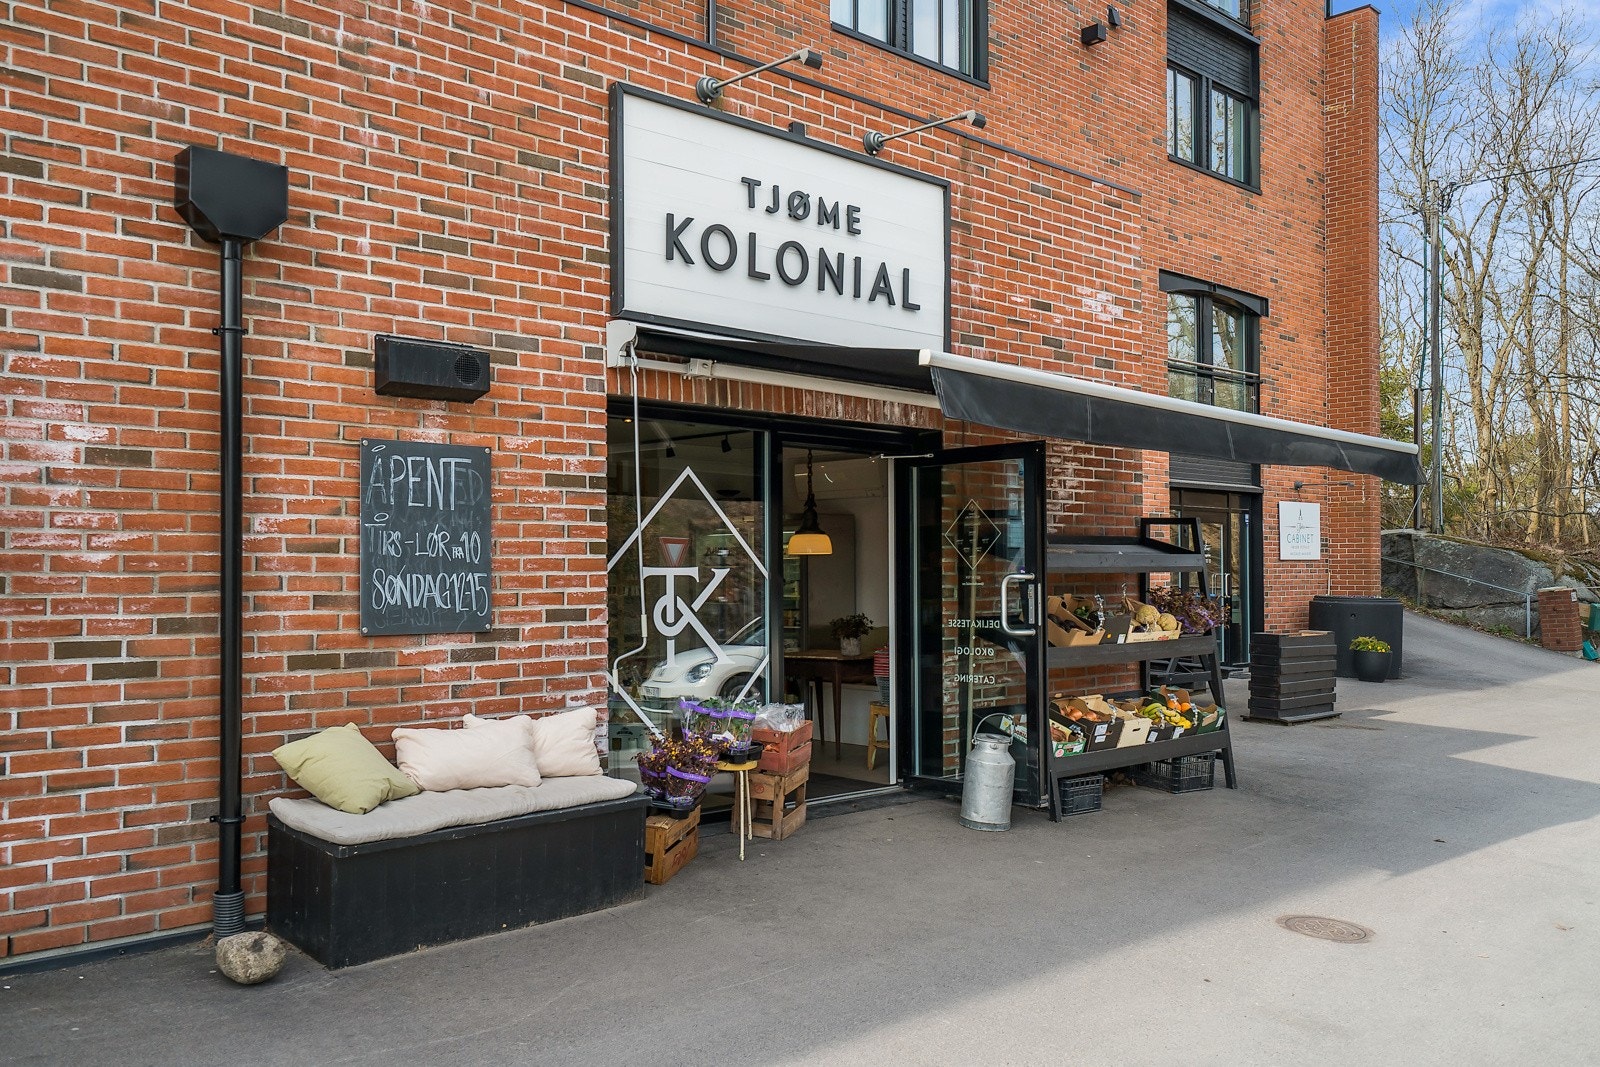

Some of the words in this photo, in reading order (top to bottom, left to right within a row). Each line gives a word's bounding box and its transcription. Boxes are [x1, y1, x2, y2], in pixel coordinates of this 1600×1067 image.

[741, 176, 861, 235] TJØME
[665, 212, 921, 311] KOLONIAL
[365, 445, 472, 510] ÅPENT
[460, 531, 481, 564] 10
[1286, 533, 1314, 544] CABINET
[372, 566, 451, 614] SØNDAG
